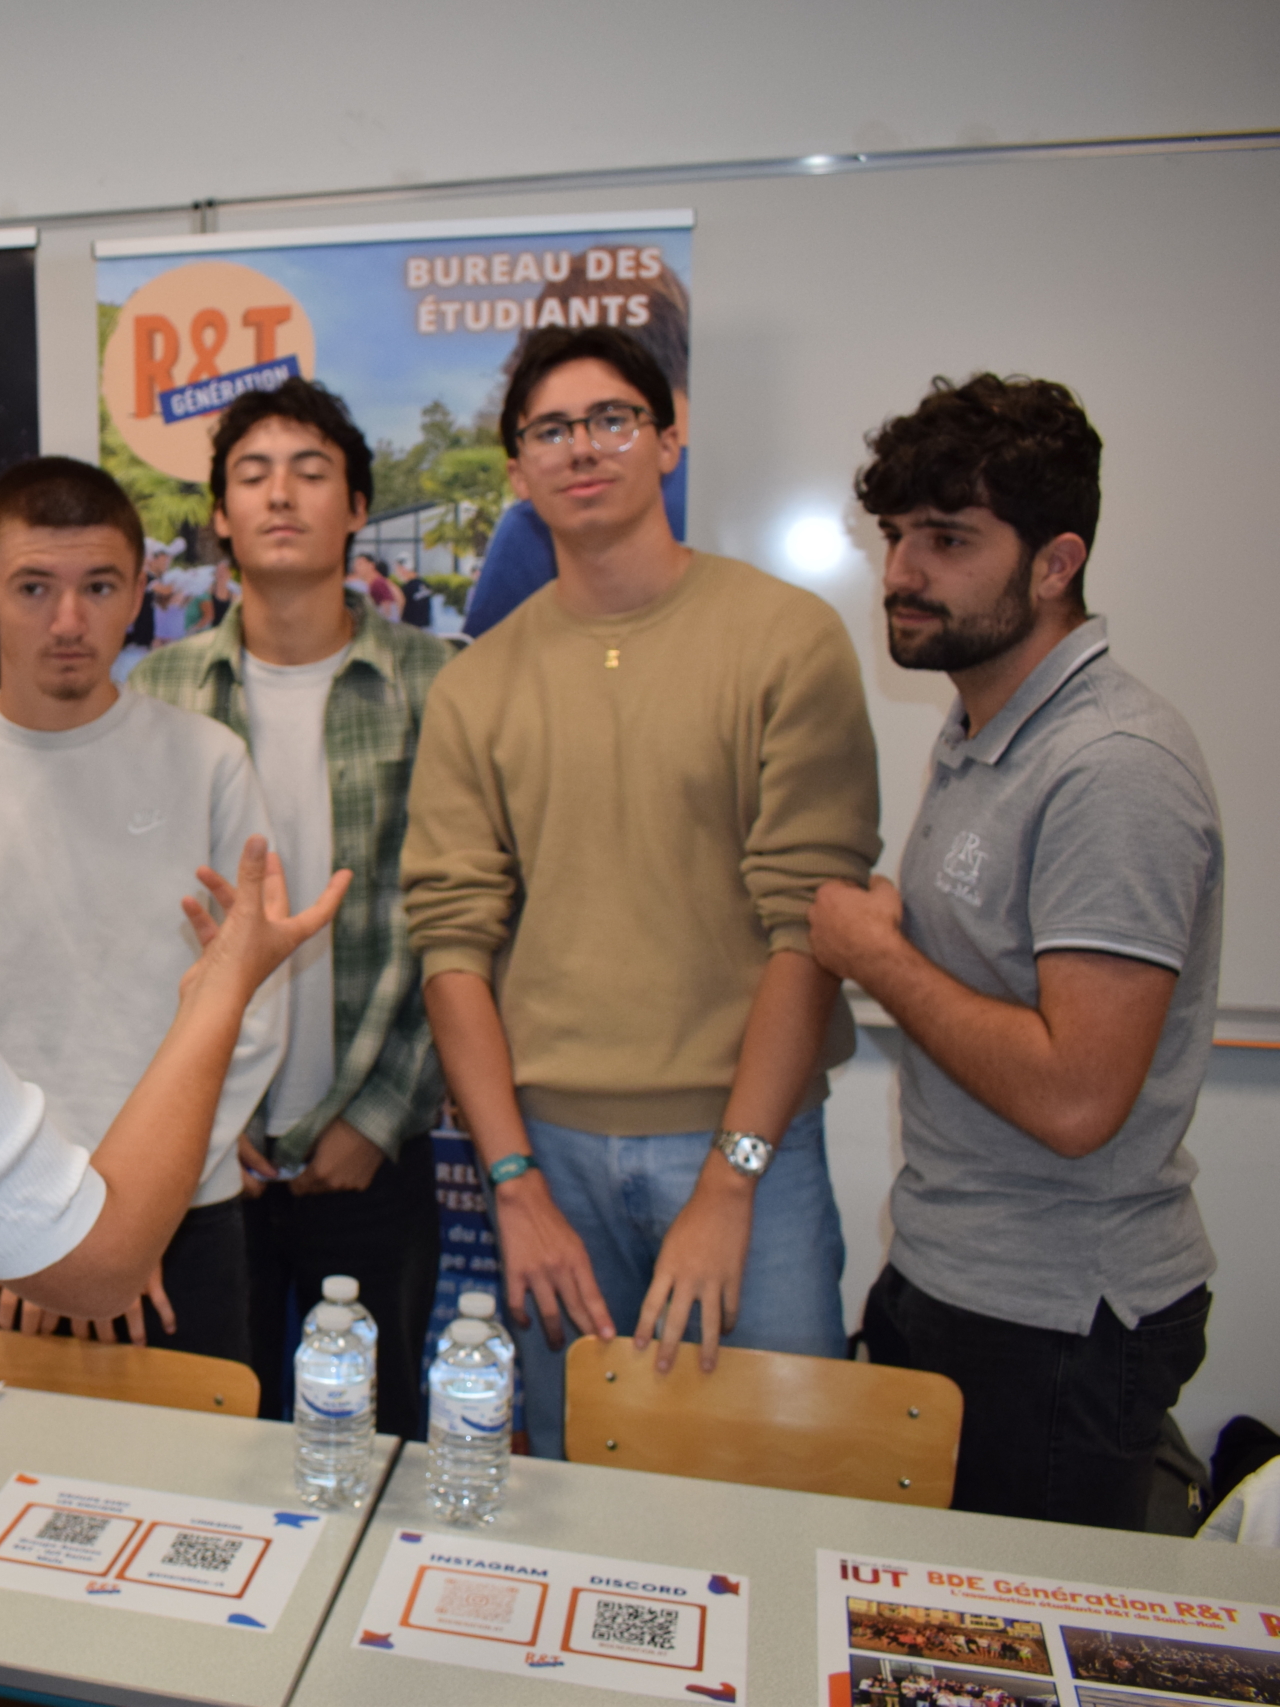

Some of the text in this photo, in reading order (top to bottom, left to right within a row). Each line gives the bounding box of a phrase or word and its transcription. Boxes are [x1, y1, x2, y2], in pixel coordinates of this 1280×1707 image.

[407, 247, 662, 288] BUREAU DES
[417, 294, 651, 334] ÉTUDIANTS
[133, 305, 292, 420] R&T
[430, 1554, 549, 1577] INSTAGRAM
[590, 1576, 687, 1596] DISCORD
[927, 1571, 1238, 1623] BDE Génération R&T
